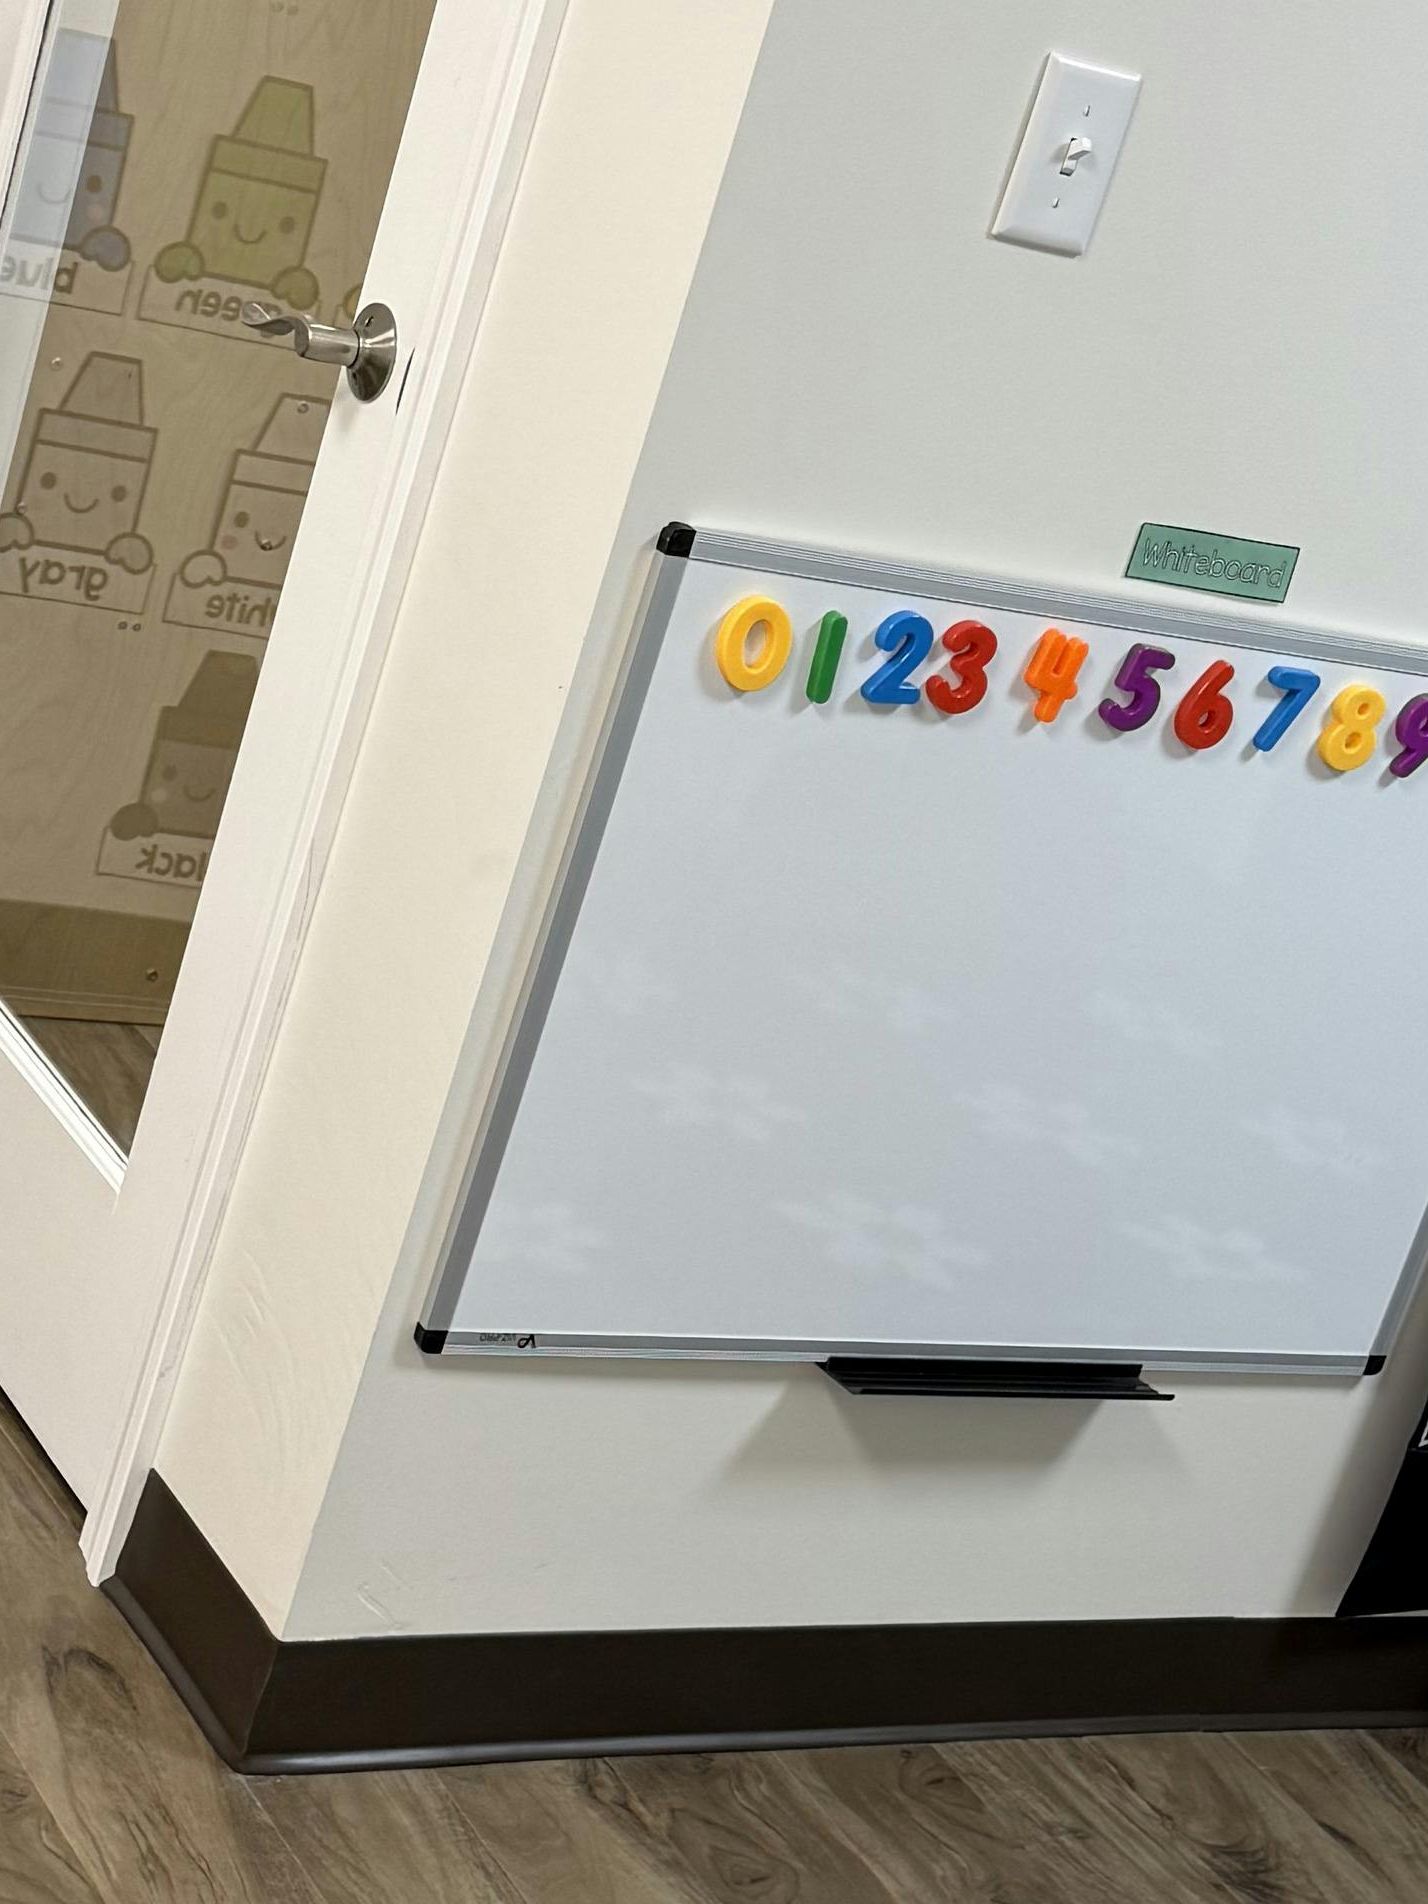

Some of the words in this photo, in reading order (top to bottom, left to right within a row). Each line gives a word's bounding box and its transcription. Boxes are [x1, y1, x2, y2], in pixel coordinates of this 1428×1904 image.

[1142, 538, 1287, 589] Whiteboard
[717, 596, 793, 691] 0
[806, 611, 848, 703] 1
[861, 610, 933, 705] 2
[926, 621, 998, 714] 3
[1024, 629, 1089, 723] 4
[1099, 644, 1175, 732] 5
[1174, 660, 1235, 749] 6
[1253, 667, 1321, 752] 7
[1318, 685, 1386, 771] 8
